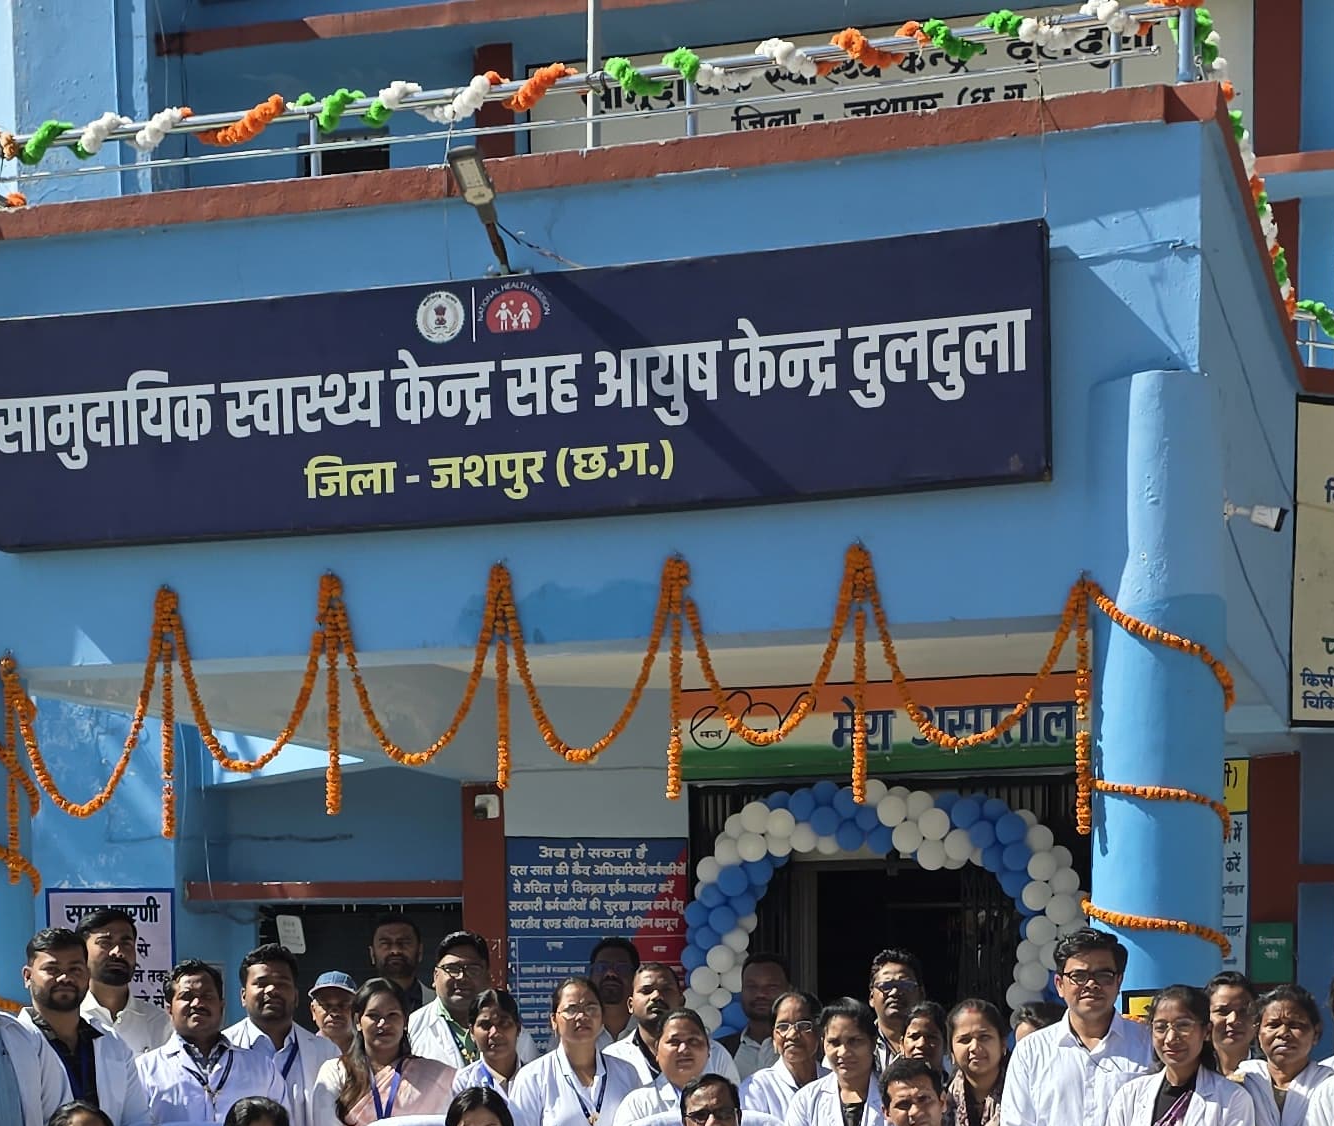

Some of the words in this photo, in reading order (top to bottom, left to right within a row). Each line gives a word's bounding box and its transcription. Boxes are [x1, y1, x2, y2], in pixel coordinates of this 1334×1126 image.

[501, 281, 530, 292] HEALTH
[221, 369, 384, 436] स्वास्थ्य
[390, 349, 495, 425] केन्द्र
[501, 353, 582, 417] सह
[595, 339, 723, 427] आयुष
[730, 318, 841, 397] केन्द्र
[848, 309, 1032, 409] दुलदुला
[304, 455, 396, 499] जिला
[428, 451, 547, 501] जशपुर
[555, 439, 675, 488] (छ.ग.)
[539, 845, 566, 859] अब
[569, 842, 586, 859] हो
[588, 847, 632, 860] सकता
